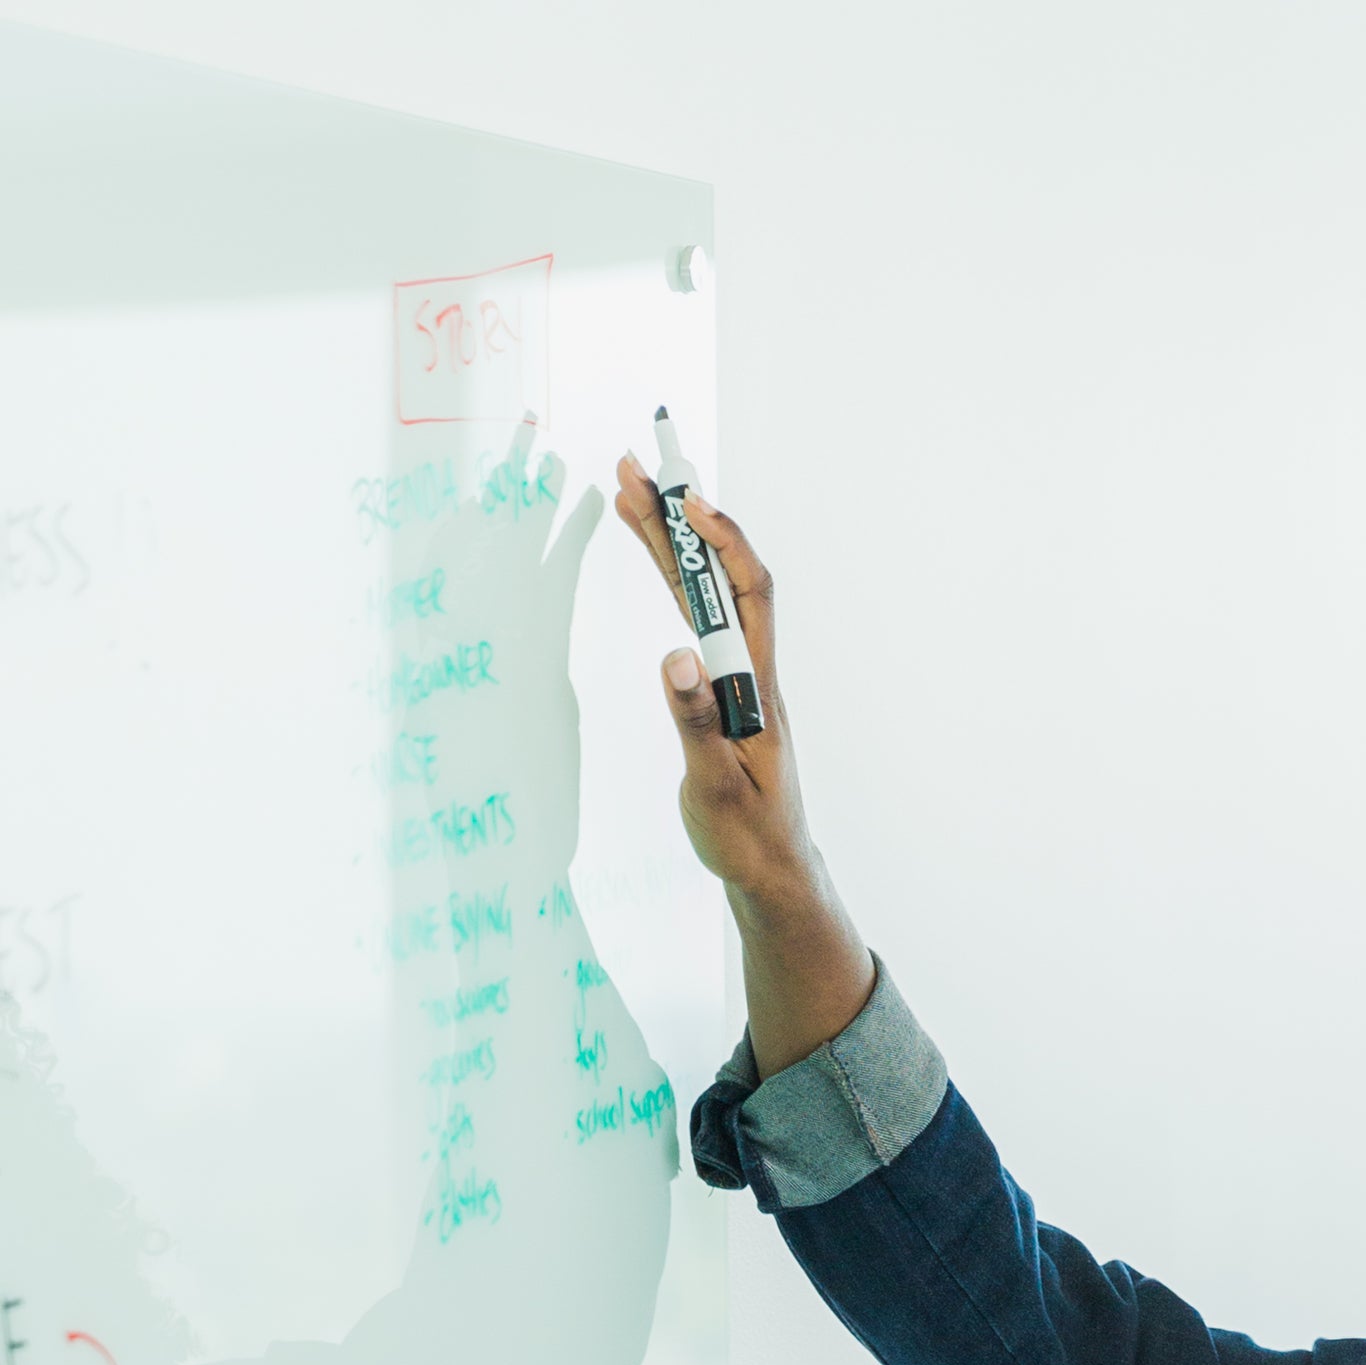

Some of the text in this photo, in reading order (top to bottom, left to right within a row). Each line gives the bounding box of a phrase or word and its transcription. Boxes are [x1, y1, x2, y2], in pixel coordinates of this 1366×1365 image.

[700, 577, 719, 620] low odor
[575, 1085, 626, 1148] school
